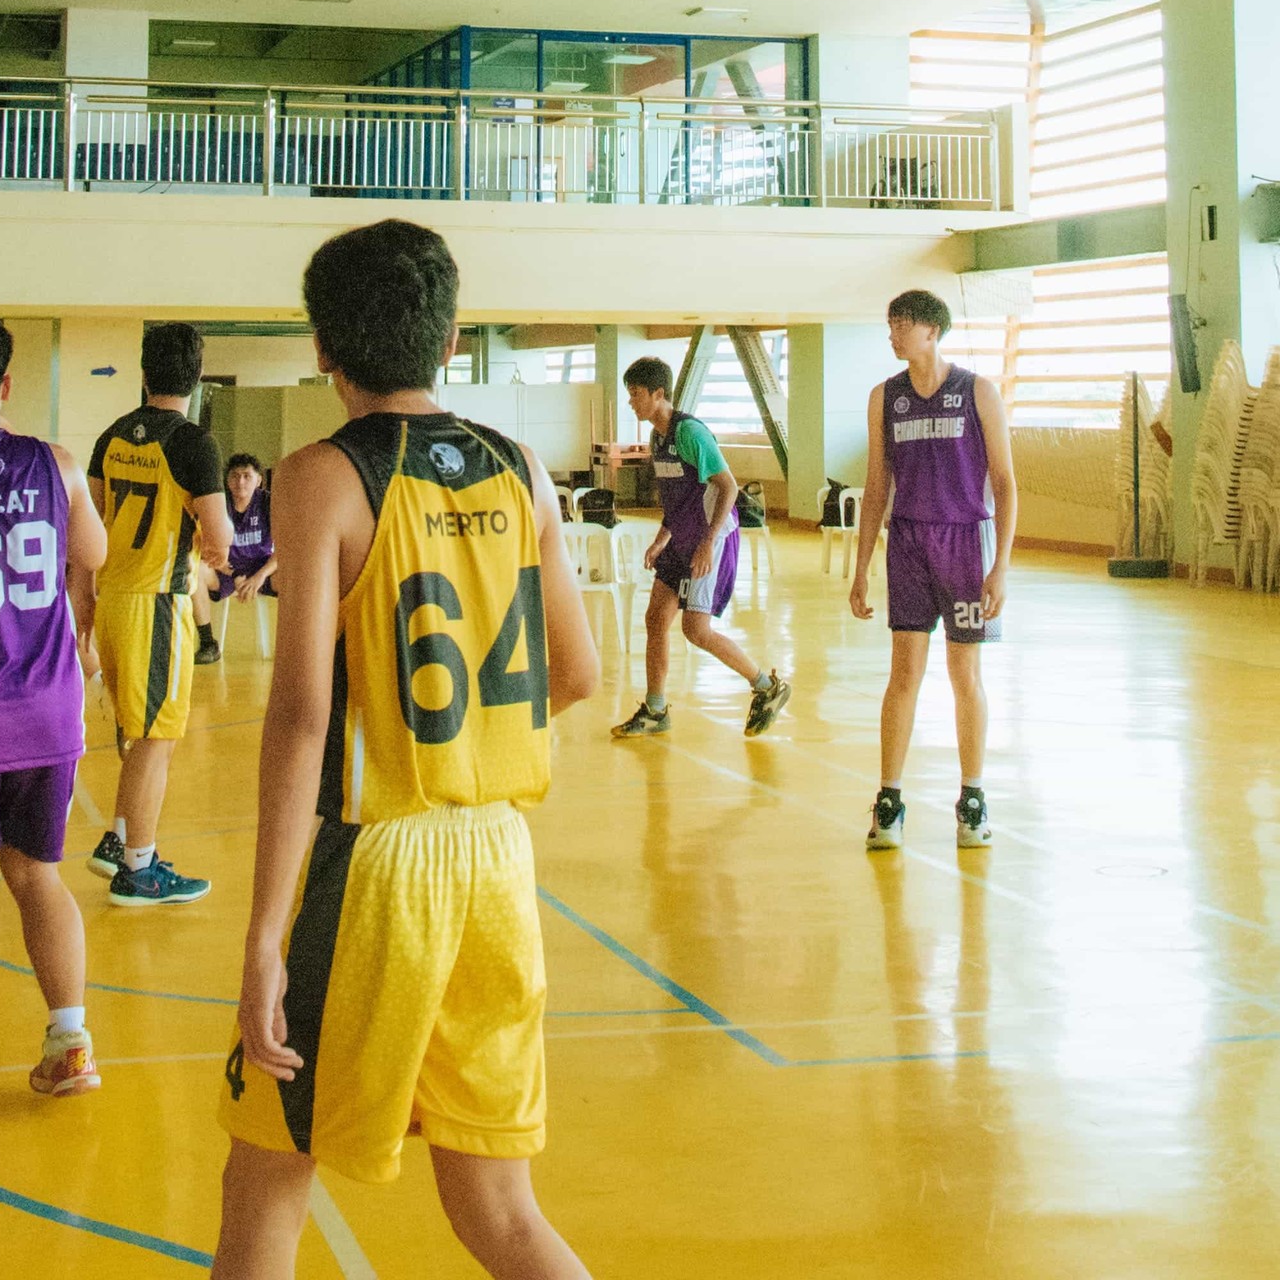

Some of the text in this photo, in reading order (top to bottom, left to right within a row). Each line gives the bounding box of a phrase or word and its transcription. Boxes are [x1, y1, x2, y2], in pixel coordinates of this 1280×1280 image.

[943, 394, 963, 408] 20
[109, 477, 159, 550] 77
[424, 509, 509, 538] MERTO
[953, 601, 985, 629] 20
[394, 565, 550, 745] 64
